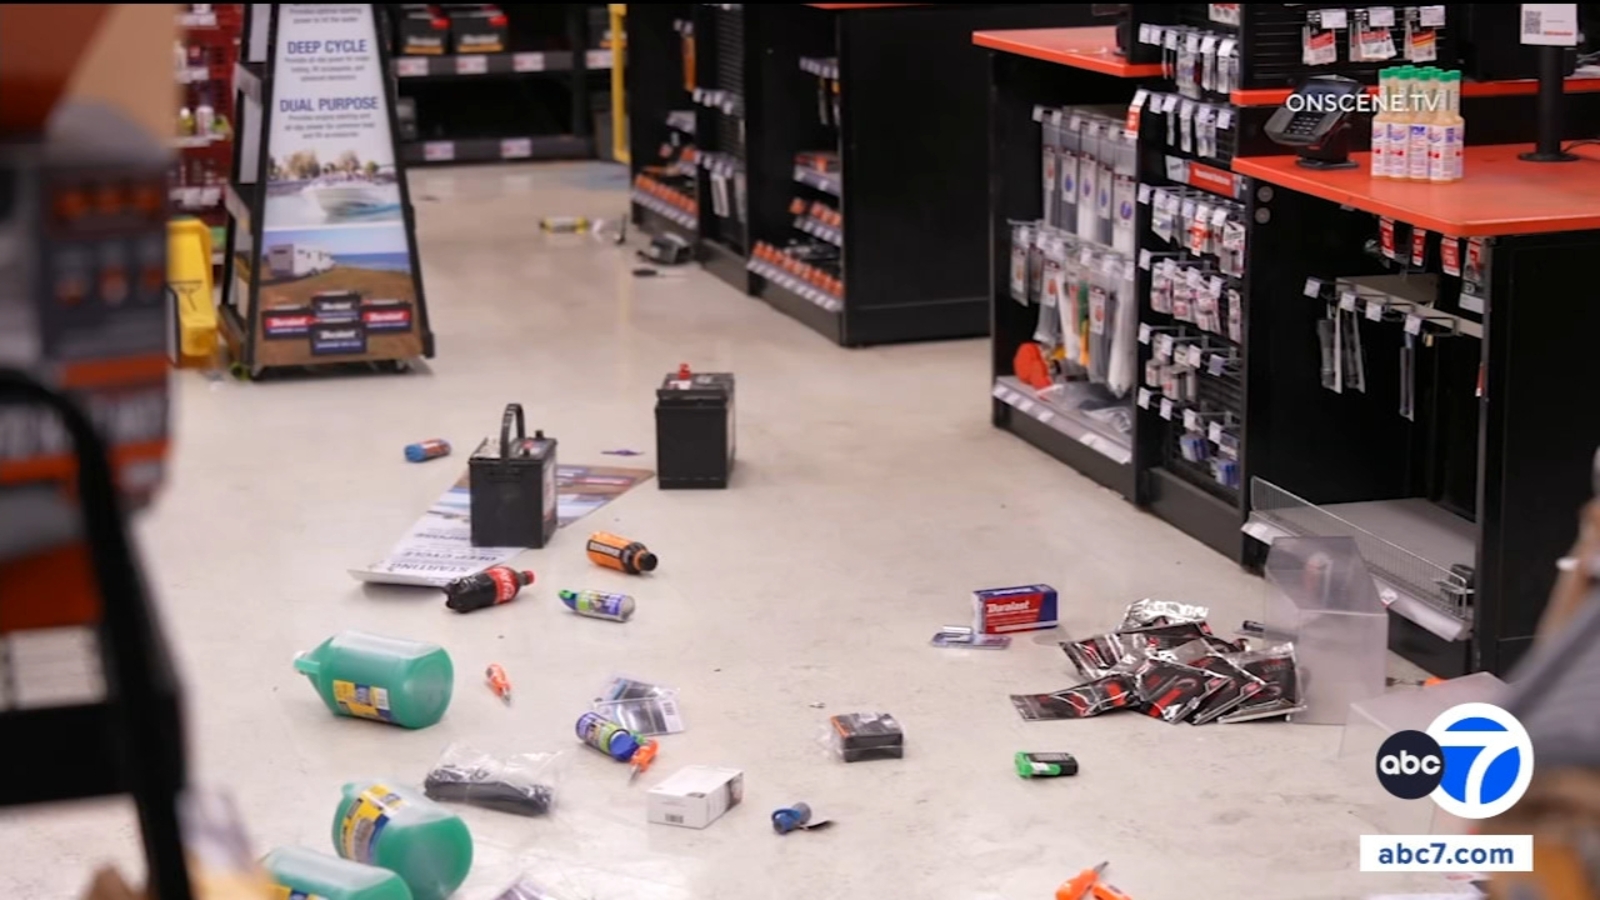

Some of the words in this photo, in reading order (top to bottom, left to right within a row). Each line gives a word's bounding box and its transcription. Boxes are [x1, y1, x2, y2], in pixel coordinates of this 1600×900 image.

[288, 41, 321, 54] DEEP
[325, 39, 367, 53] CYCLE
[280, 98, 315, 112] DUAL
[319, 96, 379, 111] PURPOSE
[986, 600, 1030, 613] Duralast
